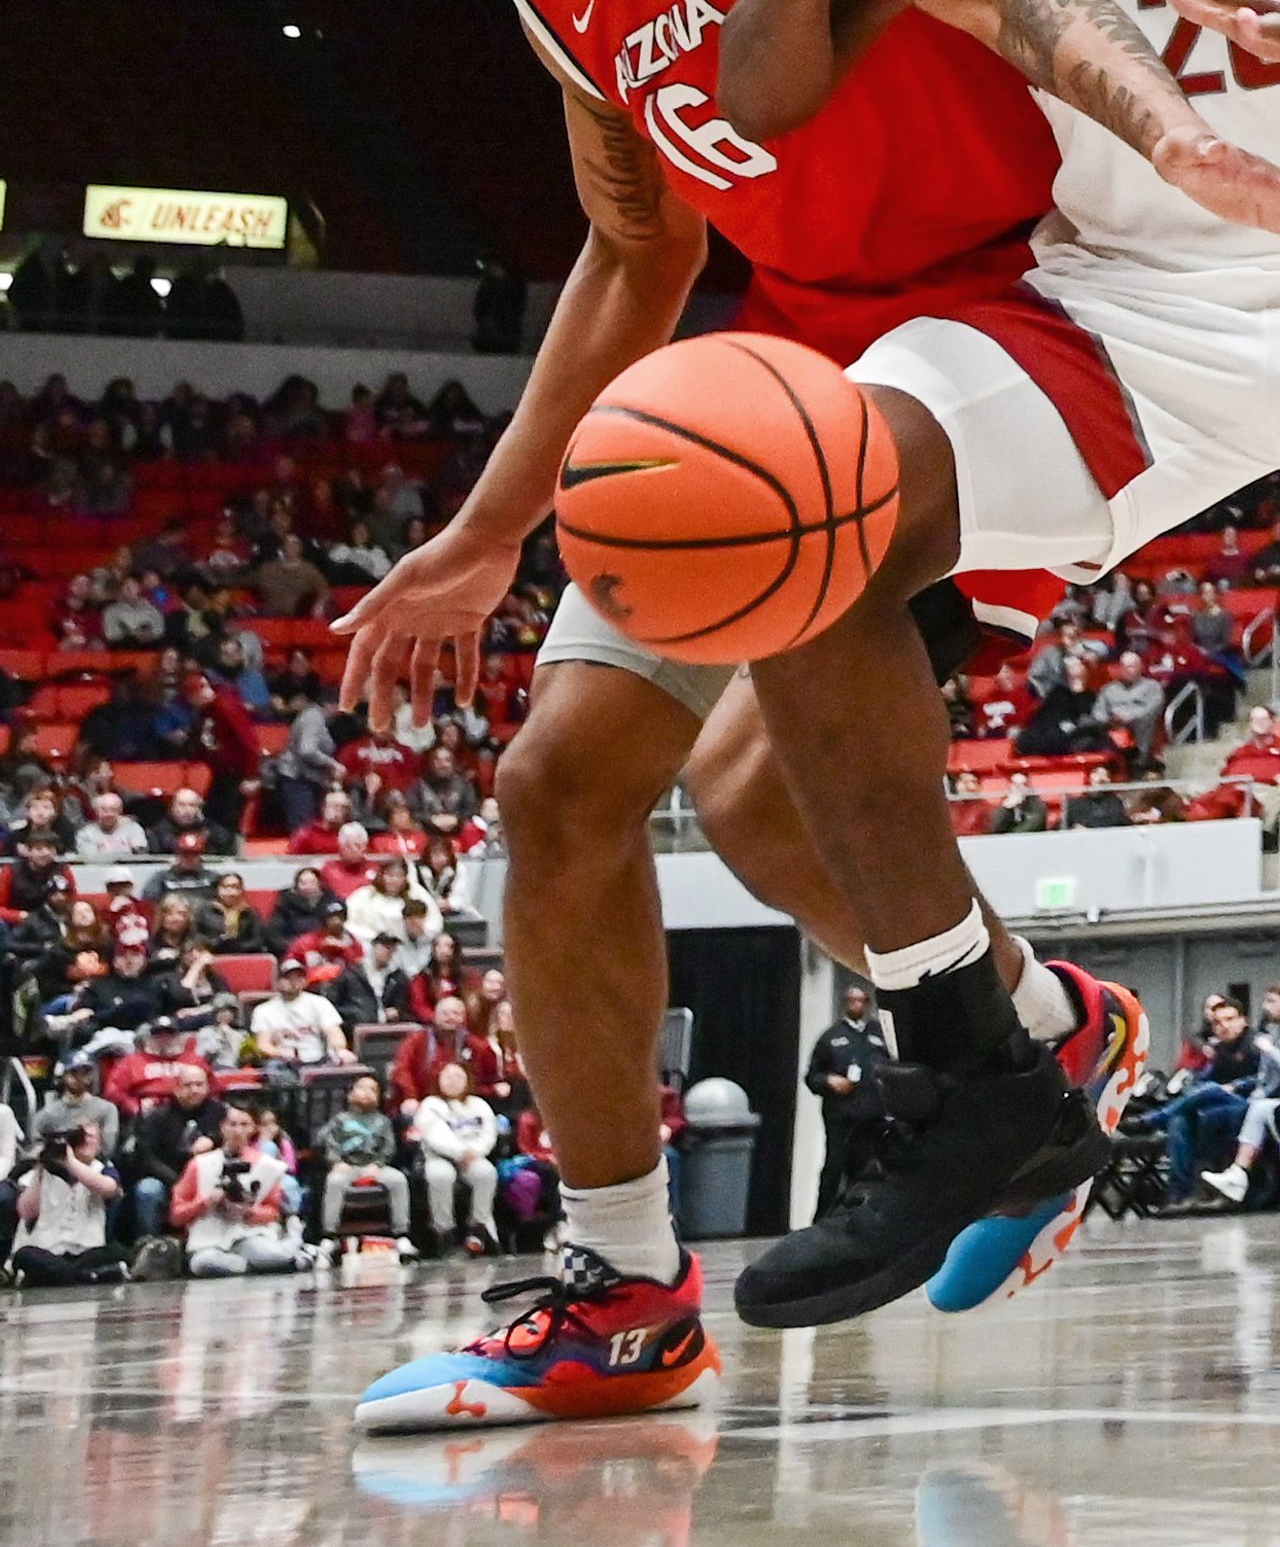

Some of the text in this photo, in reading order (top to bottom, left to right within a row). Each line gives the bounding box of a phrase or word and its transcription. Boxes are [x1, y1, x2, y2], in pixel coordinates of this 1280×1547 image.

[644, 83, 778, 190] 16
[152, 203, 274, 237] UNLEASH
[608, 1328, 647, 1367] 13
